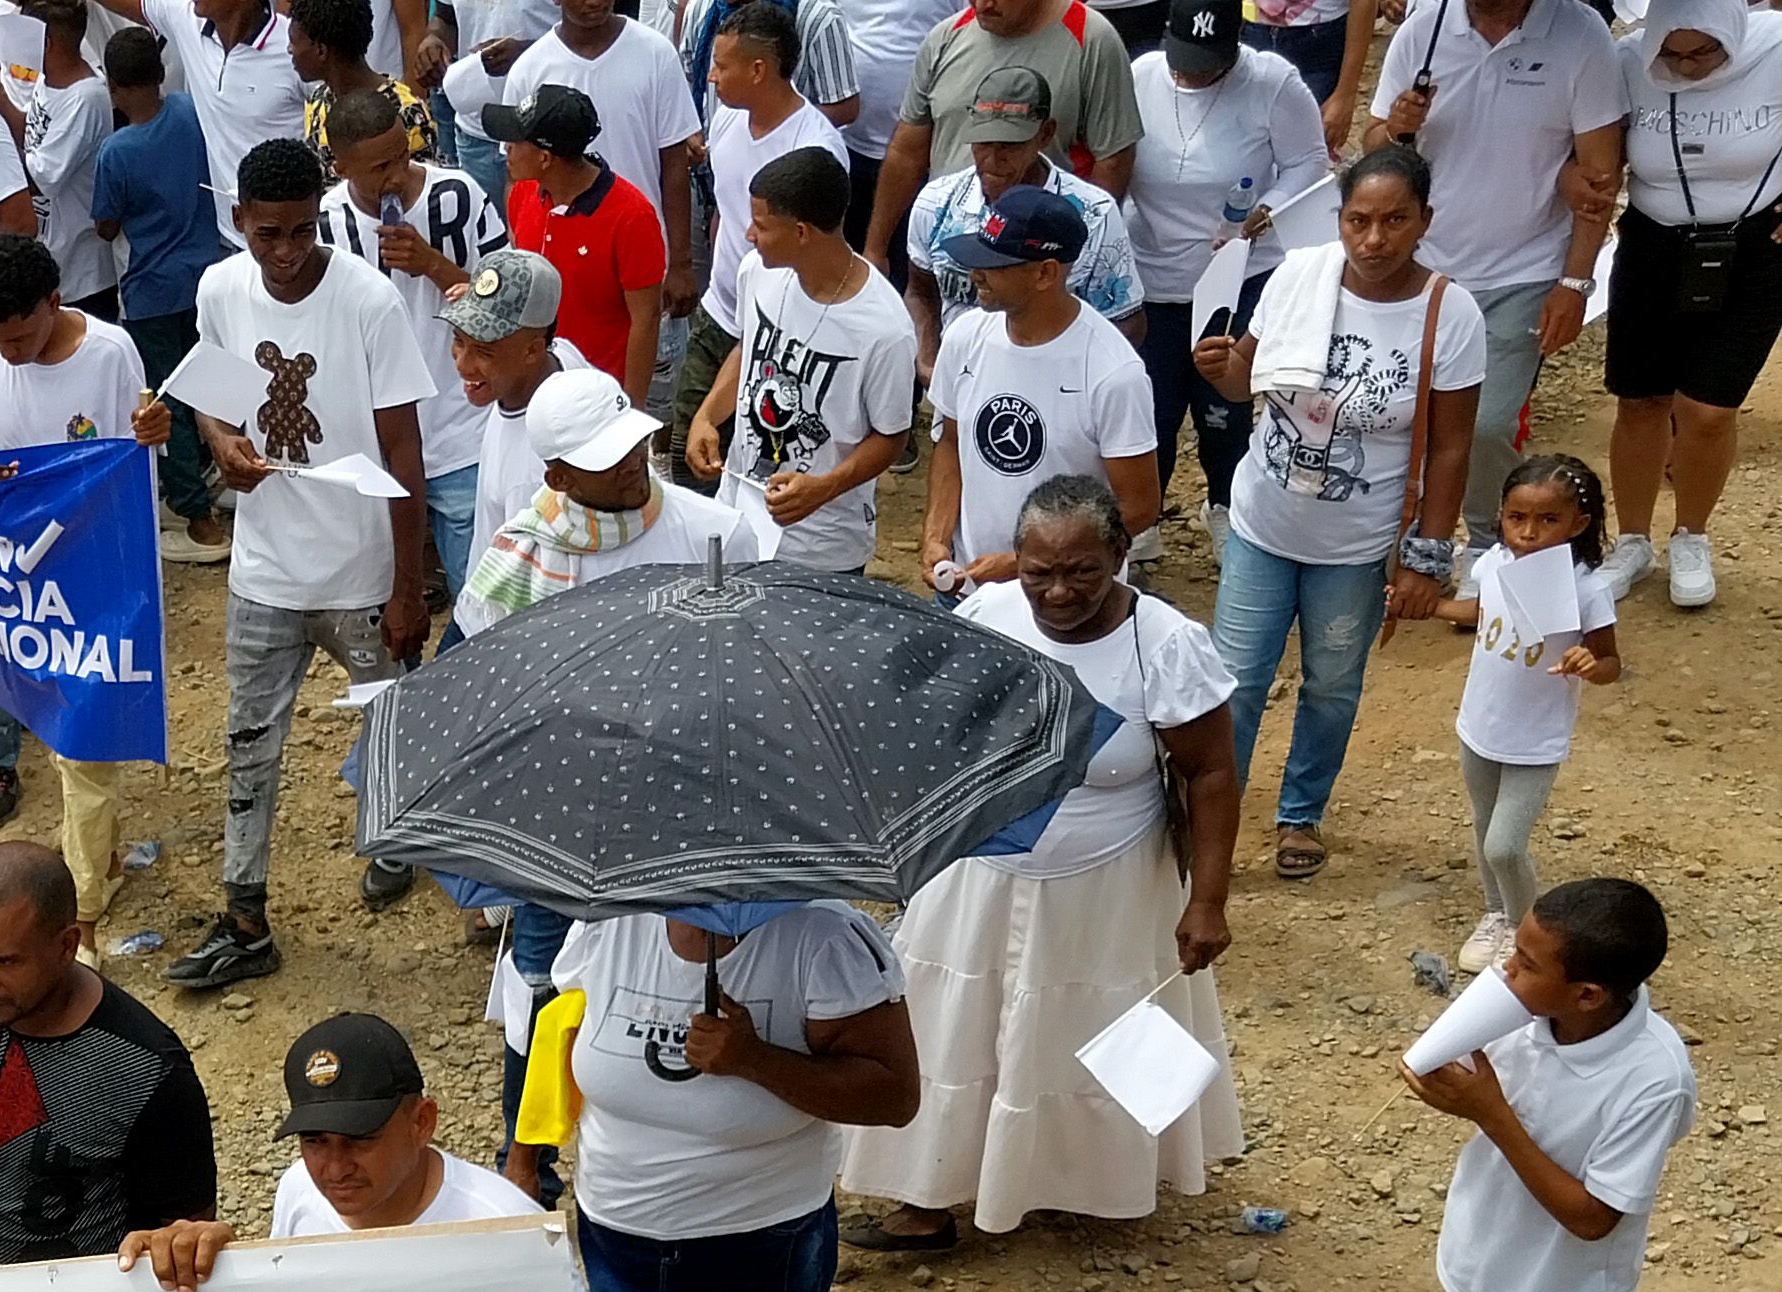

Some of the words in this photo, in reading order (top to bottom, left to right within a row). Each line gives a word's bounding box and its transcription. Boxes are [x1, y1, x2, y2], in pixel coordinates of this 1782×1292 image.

[1634, 105, 1770, 136] MOSCHINO
[990, 399, 1037, 425] PARIS
[1477, 607, 1544, 667] 020
